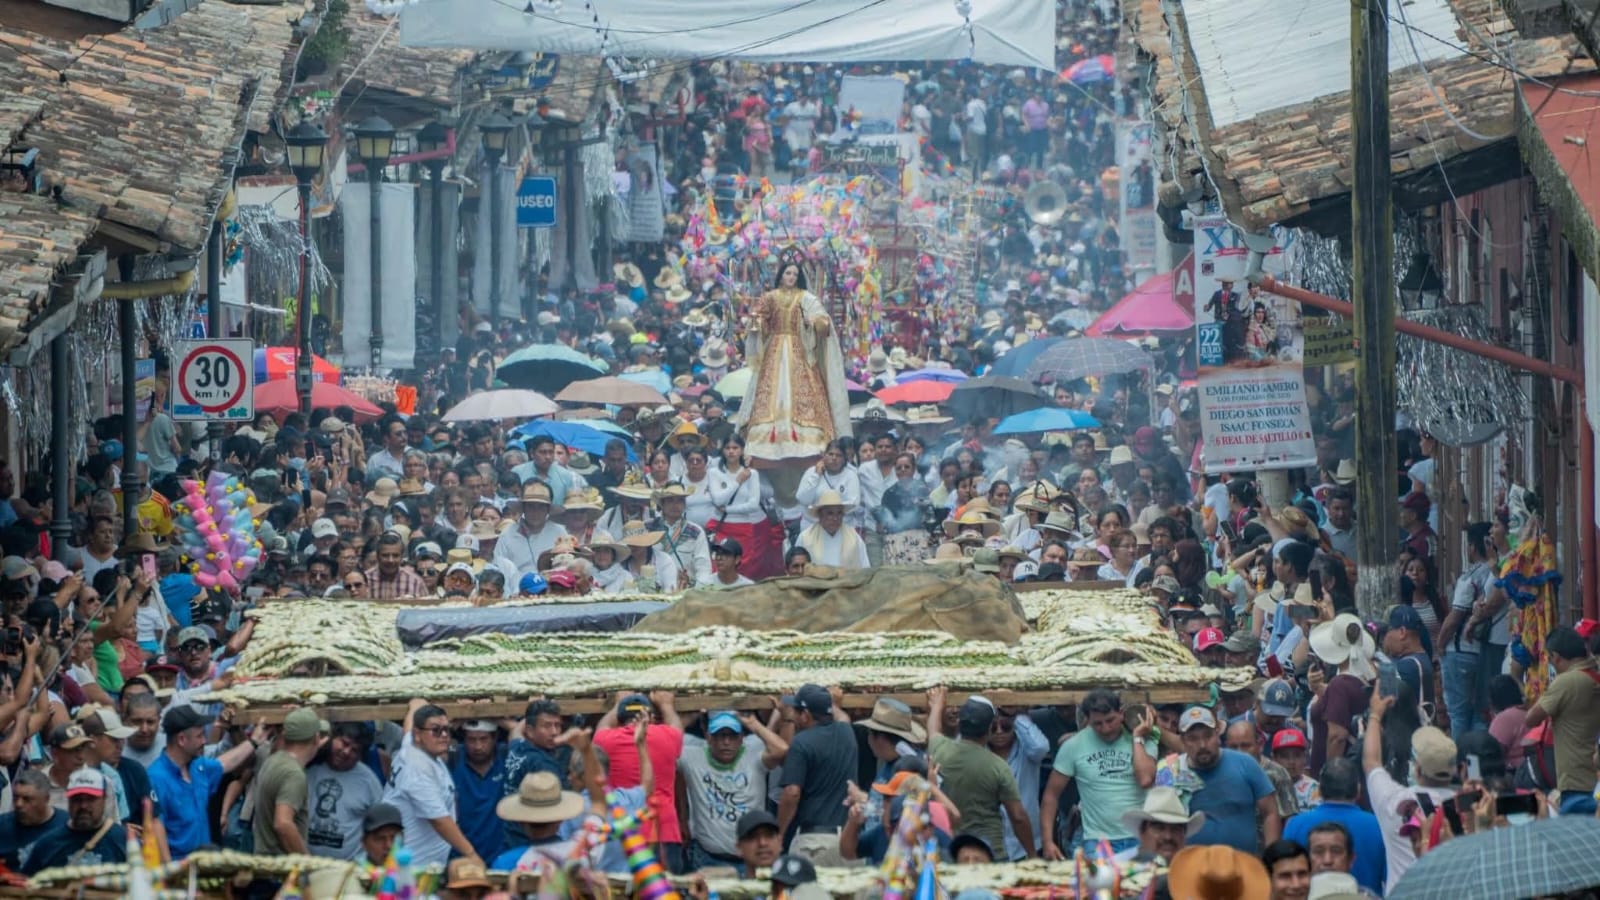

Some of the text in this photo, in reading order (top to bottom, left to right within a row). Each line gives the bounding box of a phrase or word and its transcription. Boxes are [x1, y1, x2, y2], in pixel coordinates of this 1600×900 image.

[1200, 328, 1220, 346] 22
[195, 356, 230, 388] 30
[1206, 384, 1260, 395] EMILIANO
[1210, 409, 1245, 420] DIEGO
[1247, 407, 1264, 418] SAN
[1221, 419, 1296, 432] ISAAC FONSECA
[1222, 434, 1244, 445] REAL
[1245, 434, 1259, 443] DE
